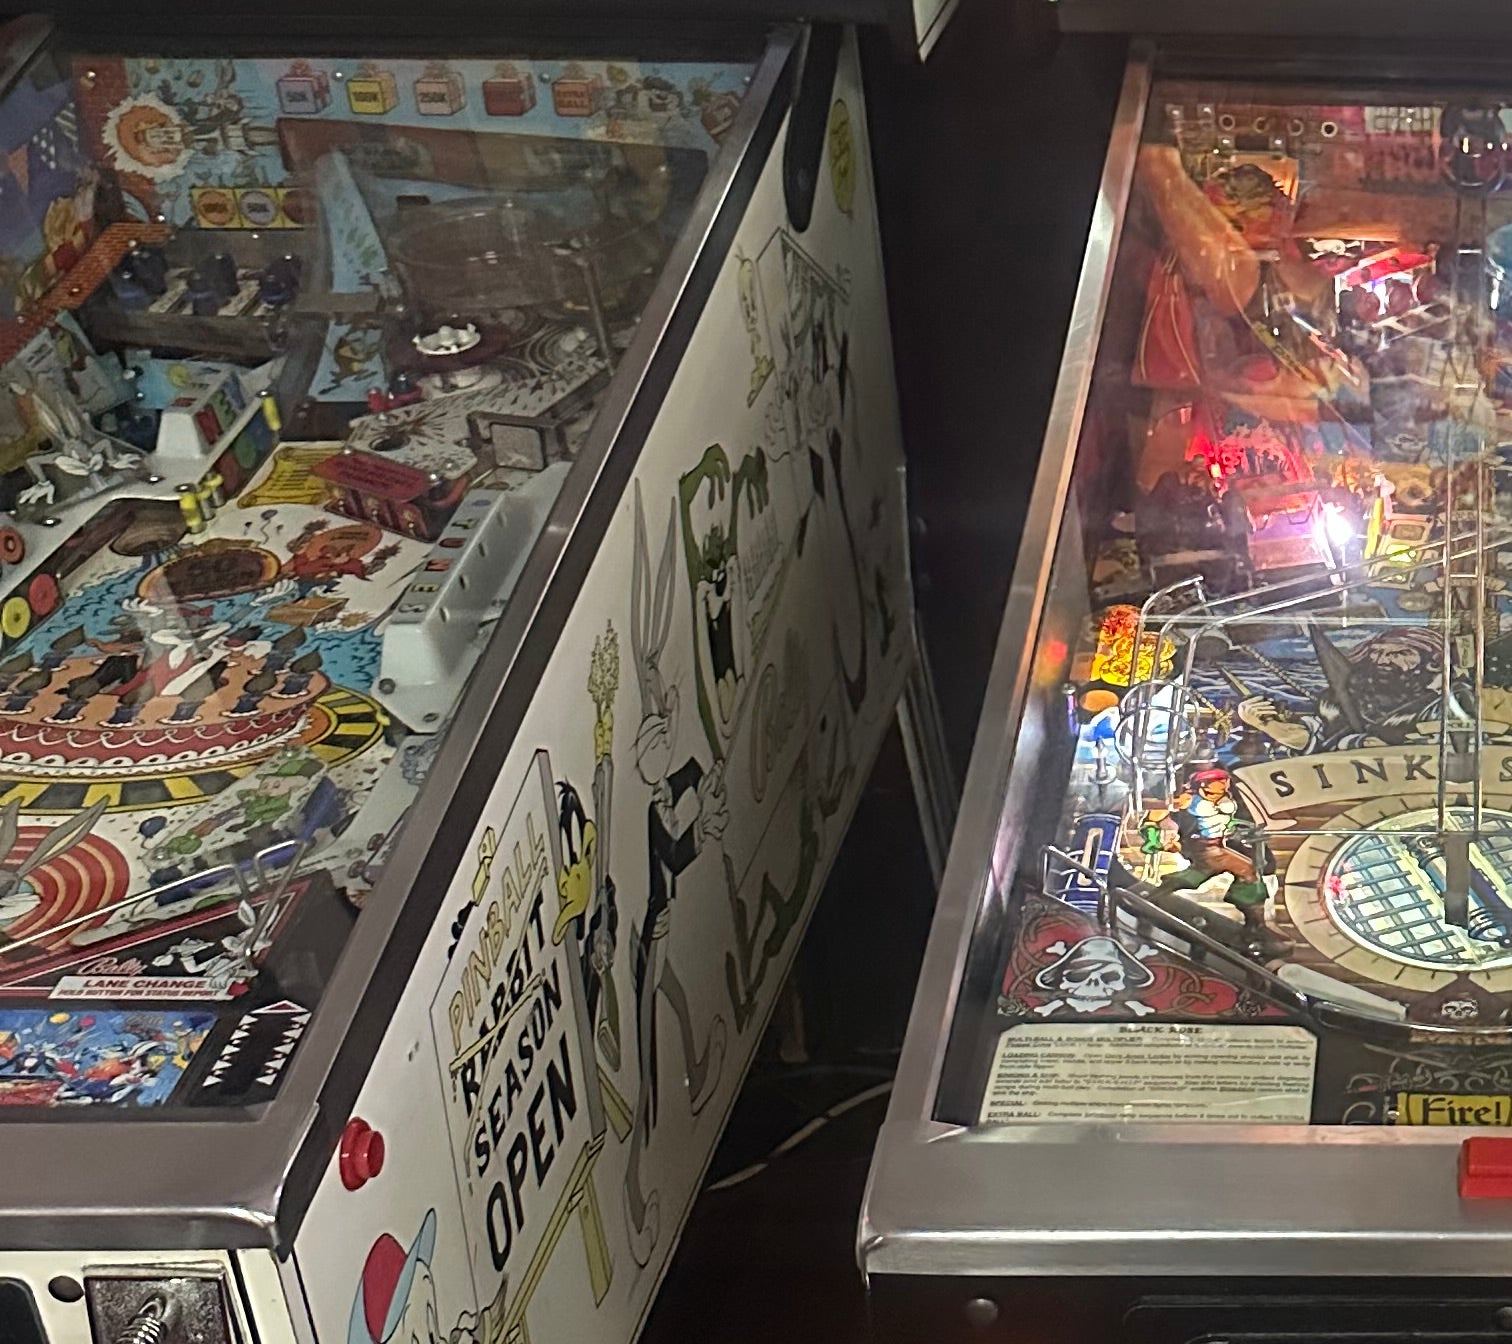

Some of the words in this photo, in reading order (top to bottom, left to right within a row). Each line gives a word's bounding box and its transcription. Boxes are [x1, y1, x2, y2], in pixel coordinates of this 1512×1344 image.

[1269, 754, 1436, 798] SINK
[448, 811, 546, 1055] PINBALL
[77, 957, 149, 975] Bally
[83, 979, 128, 988] LANE
[139, 980, 207, 989] CHANGE
[474, 959, 562, 1177] SEASON
[1422, 1097, 1502, 1125] Fire!
[486, 1031, 577, 1273] OPEN
